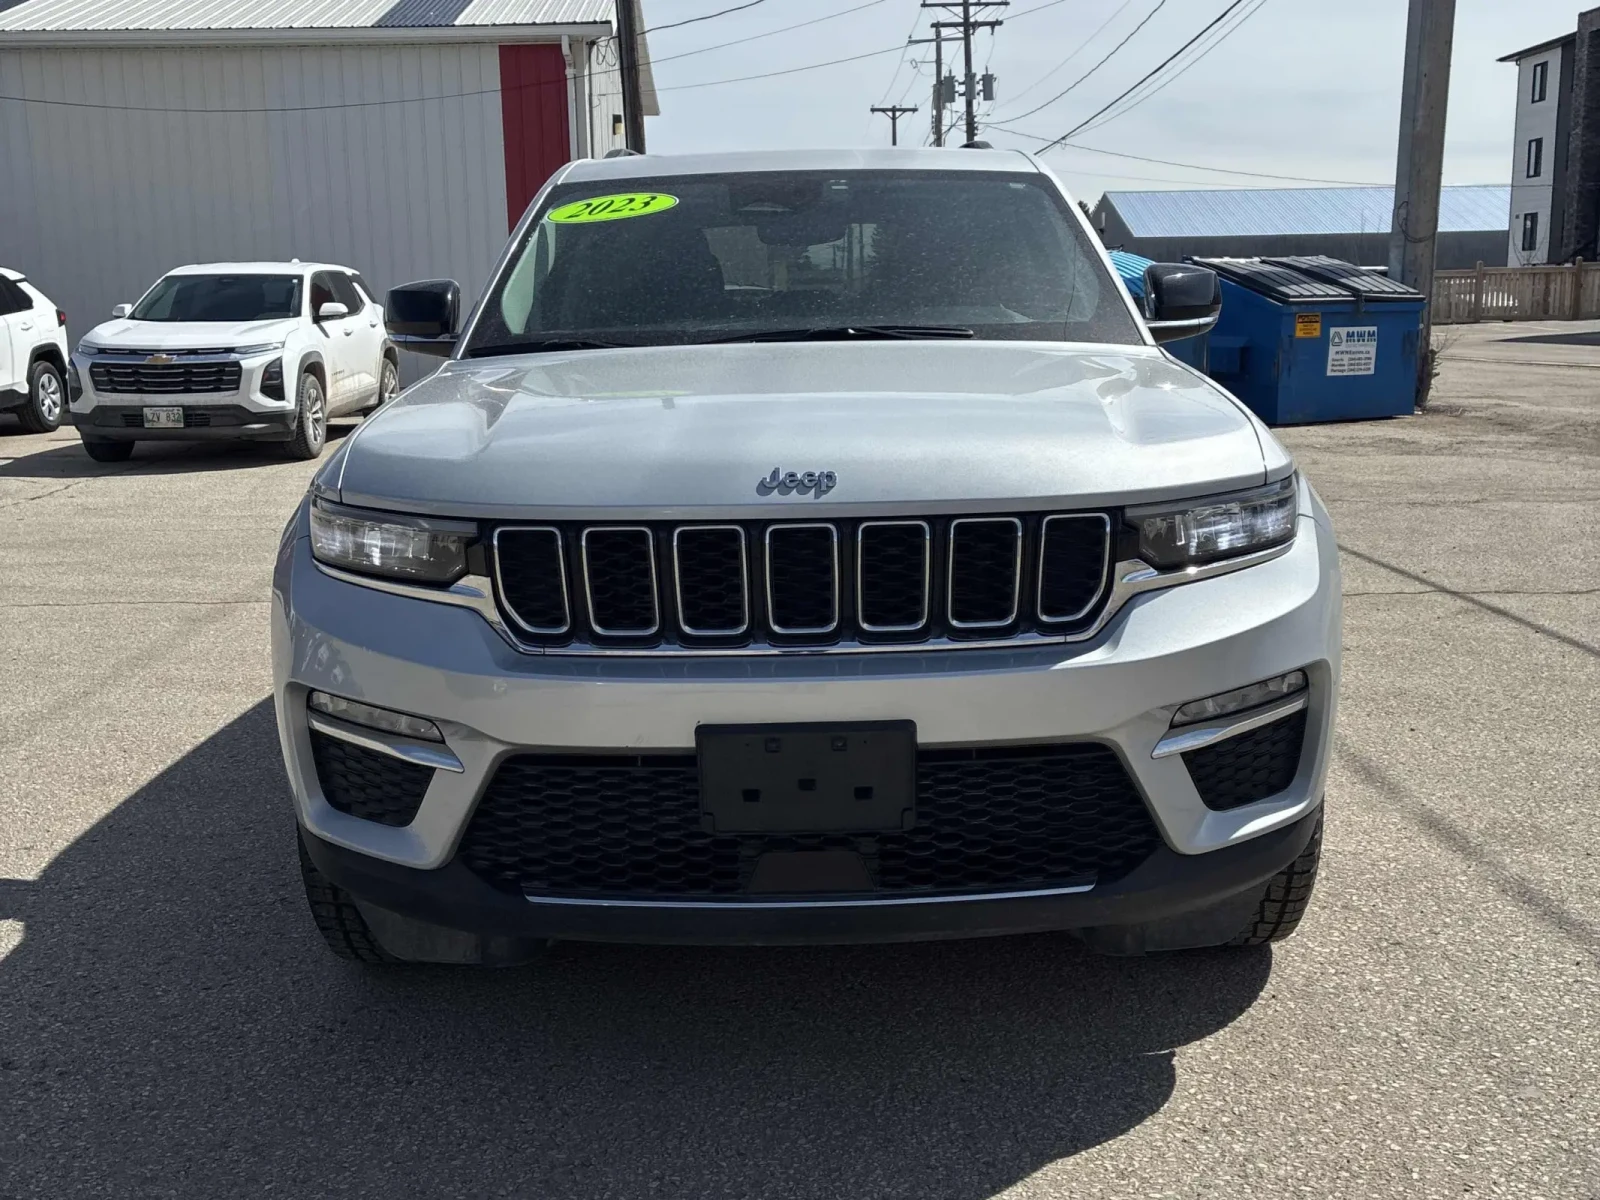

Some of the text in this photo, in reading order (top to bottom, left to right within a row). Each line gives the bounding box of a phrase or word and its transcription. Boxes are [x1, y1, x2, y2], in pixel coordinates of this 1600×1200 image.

[564, 195, 658, 219] 2023
[1346, 330, 1376, 338] MWM
[166, 412, 181, 423] 832
[760, 467, 838, 492] Jeep
